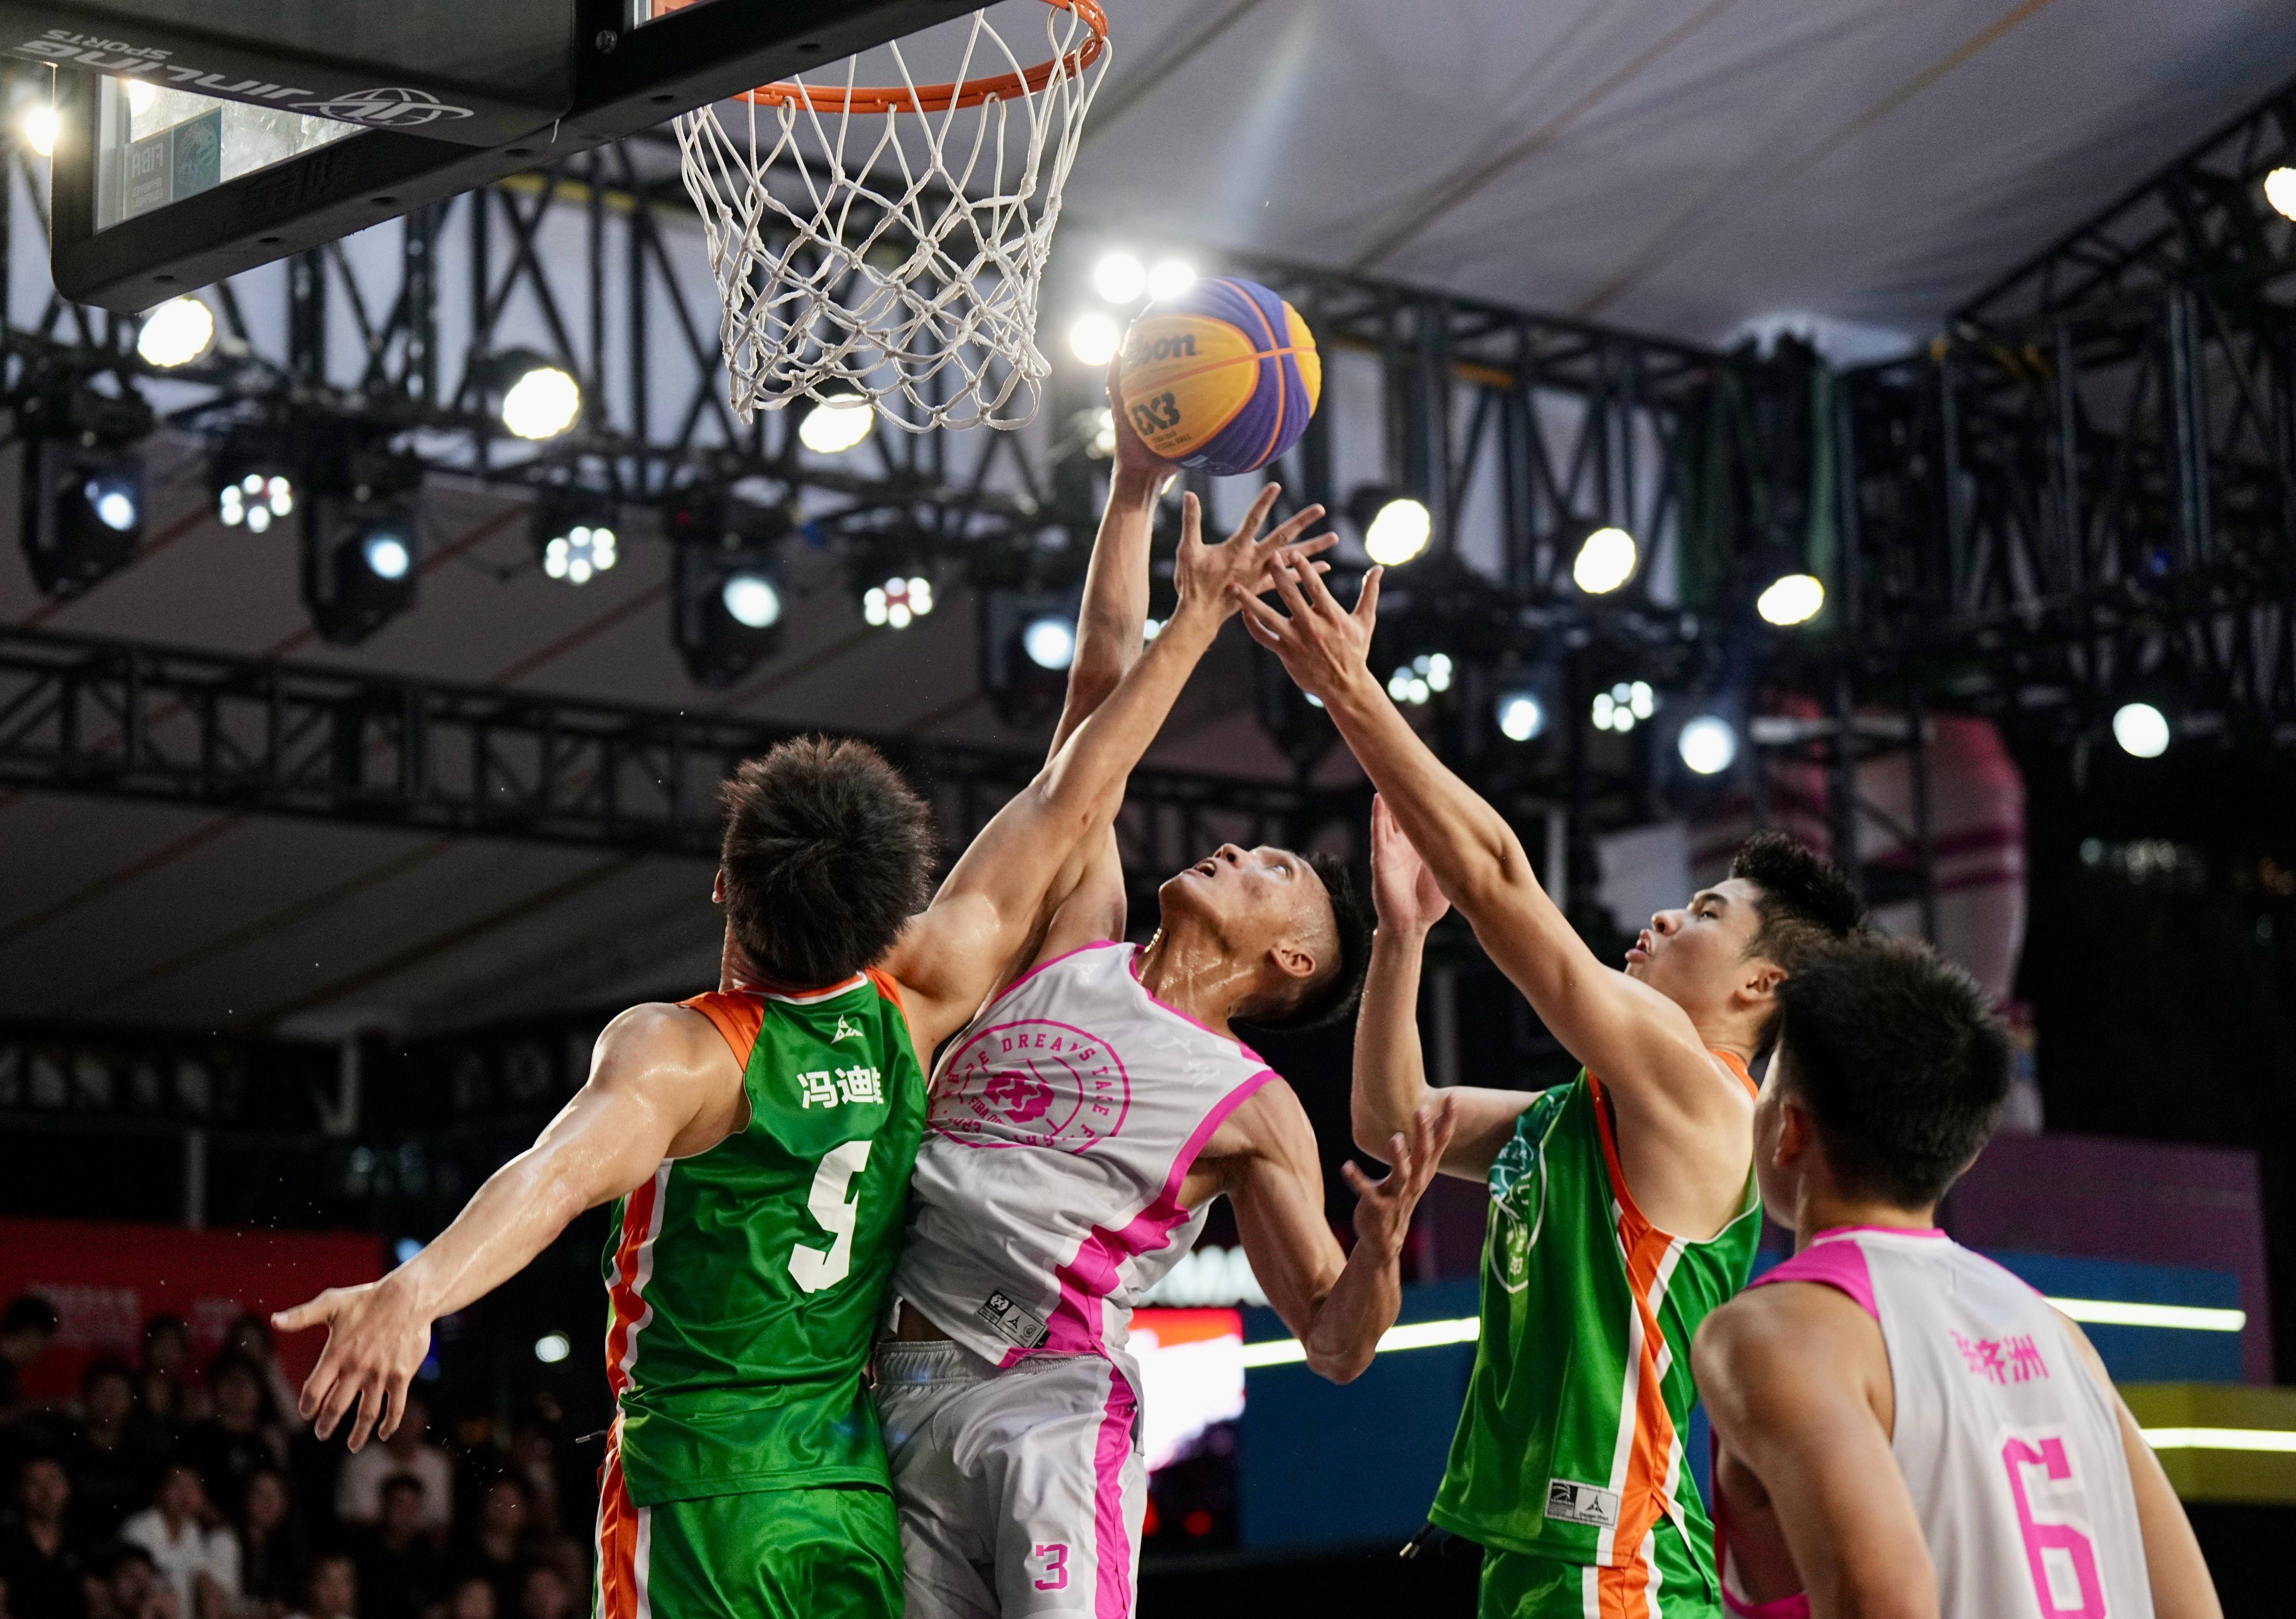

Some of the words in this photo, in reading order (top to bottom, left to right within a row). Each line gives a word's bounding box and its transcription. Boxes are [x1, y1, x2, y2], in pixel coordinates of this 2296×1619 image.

[42, 30, 173, 60] SPORTS
[968, 1095, 990, 1119] FIBA
[2001, 1437, 2107, 1619] 6
[1035, 1543, 1068, 1591] 3
